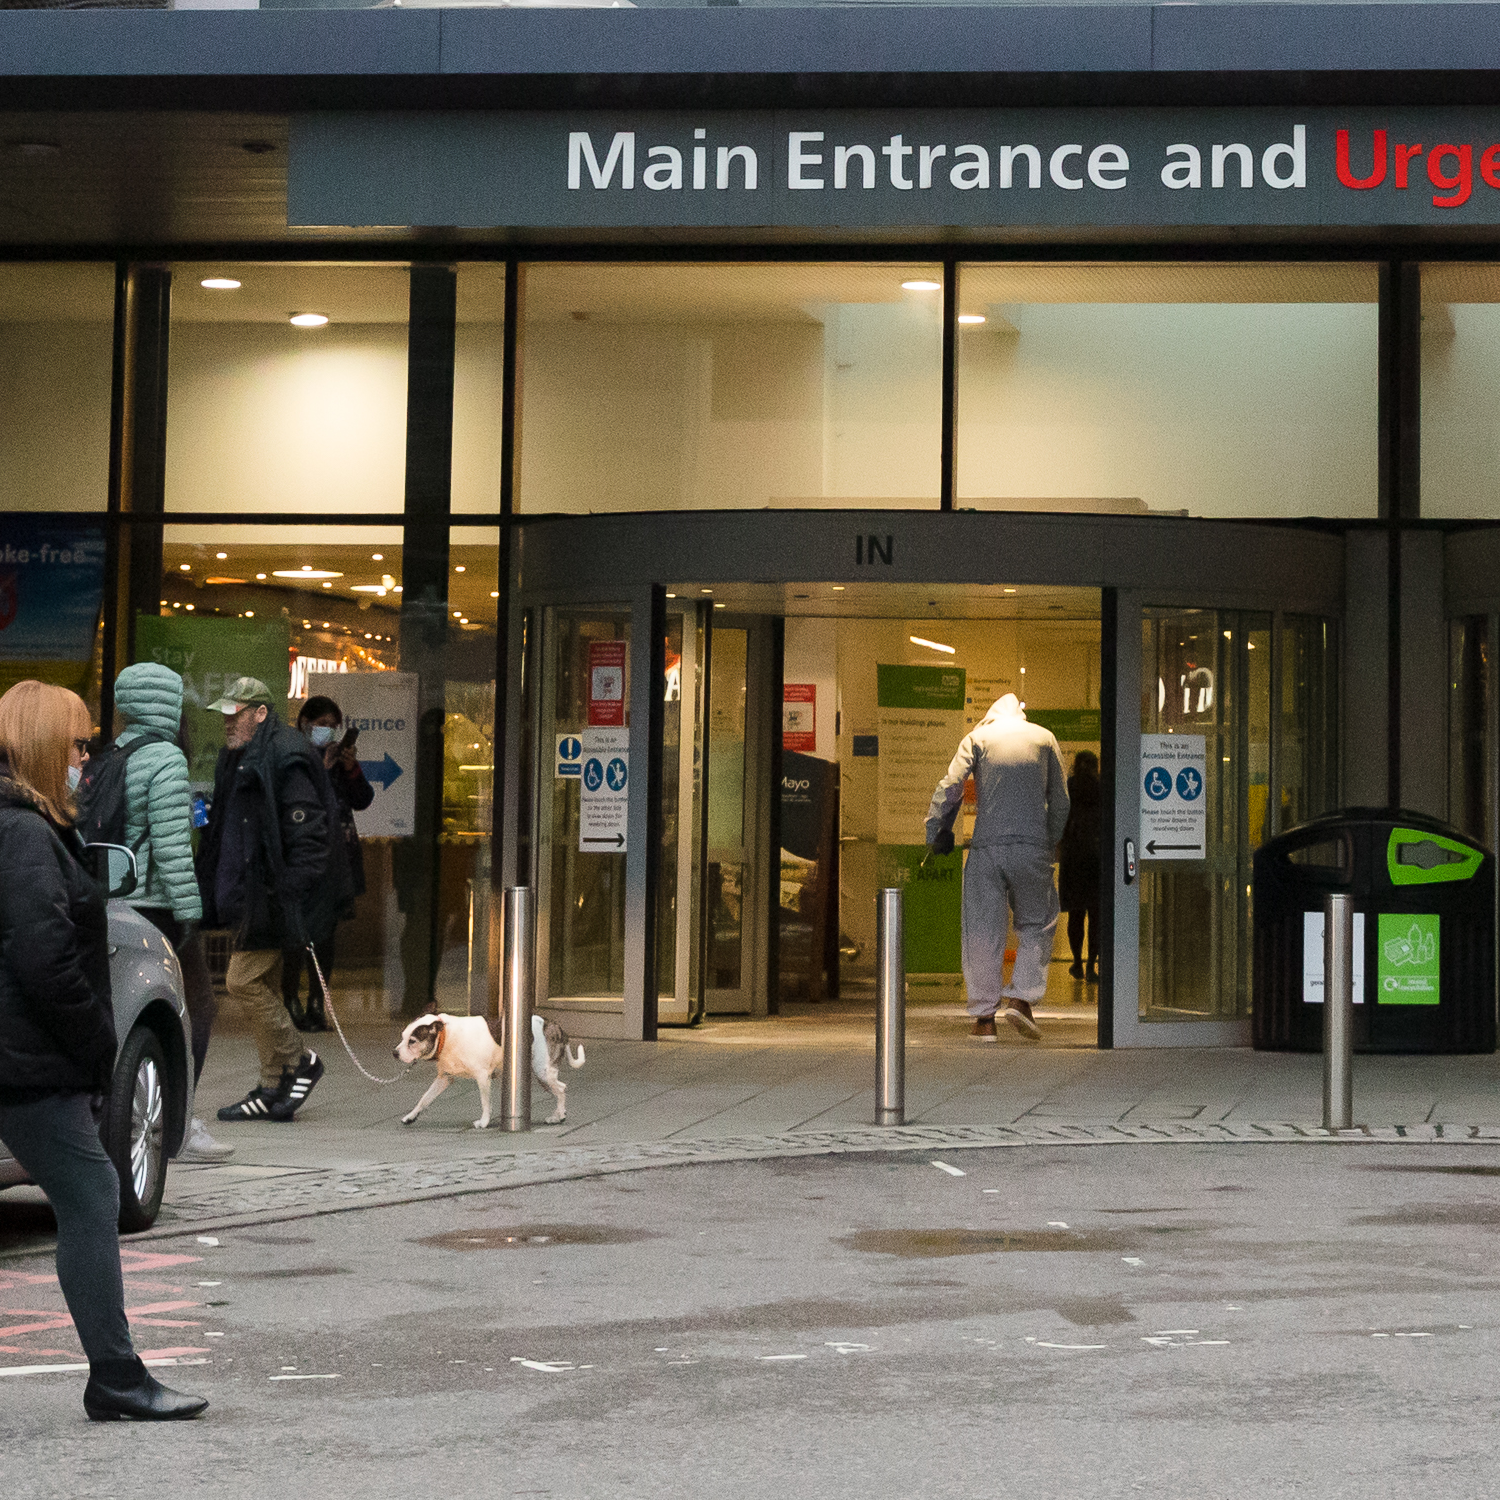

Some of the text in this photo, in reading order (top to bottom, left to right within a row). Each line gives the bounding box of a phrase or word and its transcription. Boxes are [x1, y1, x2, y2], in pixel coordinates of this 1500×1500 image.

[566, 128, 758, 191] Main
[787, 131, 1129, 190] Entrance
[1160, 124, 1306, 190] and
[855, 535, 895, 566] IN
[340, 714, 406, 731] trance
